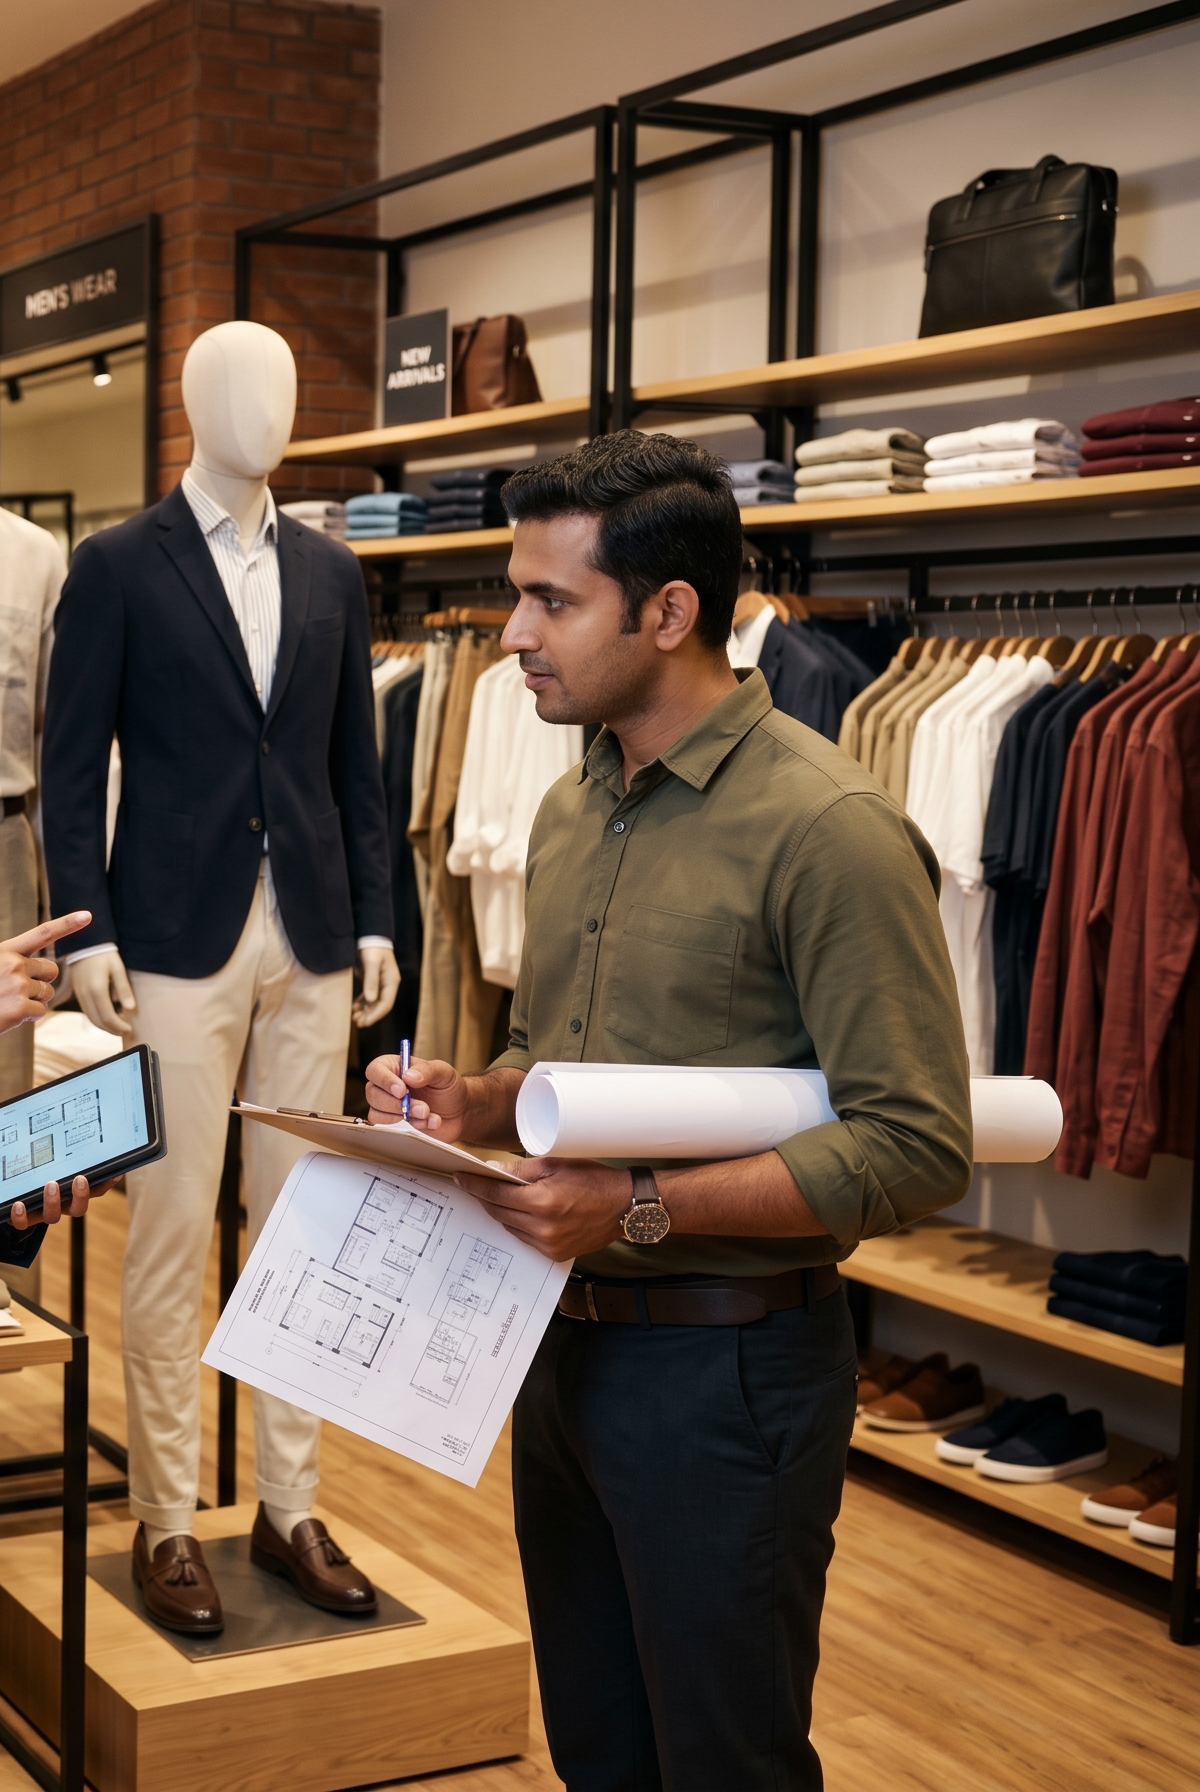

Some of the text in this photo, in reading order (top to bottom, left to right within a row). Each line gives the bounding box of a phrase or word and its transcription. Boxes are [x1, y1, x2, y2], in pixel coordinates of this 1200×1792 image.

[25, 268, 117, 319] MEN'S WEAR
[401, 345, 431, 367] NEW
[387, 363, 445, 390] ARRIVALS
